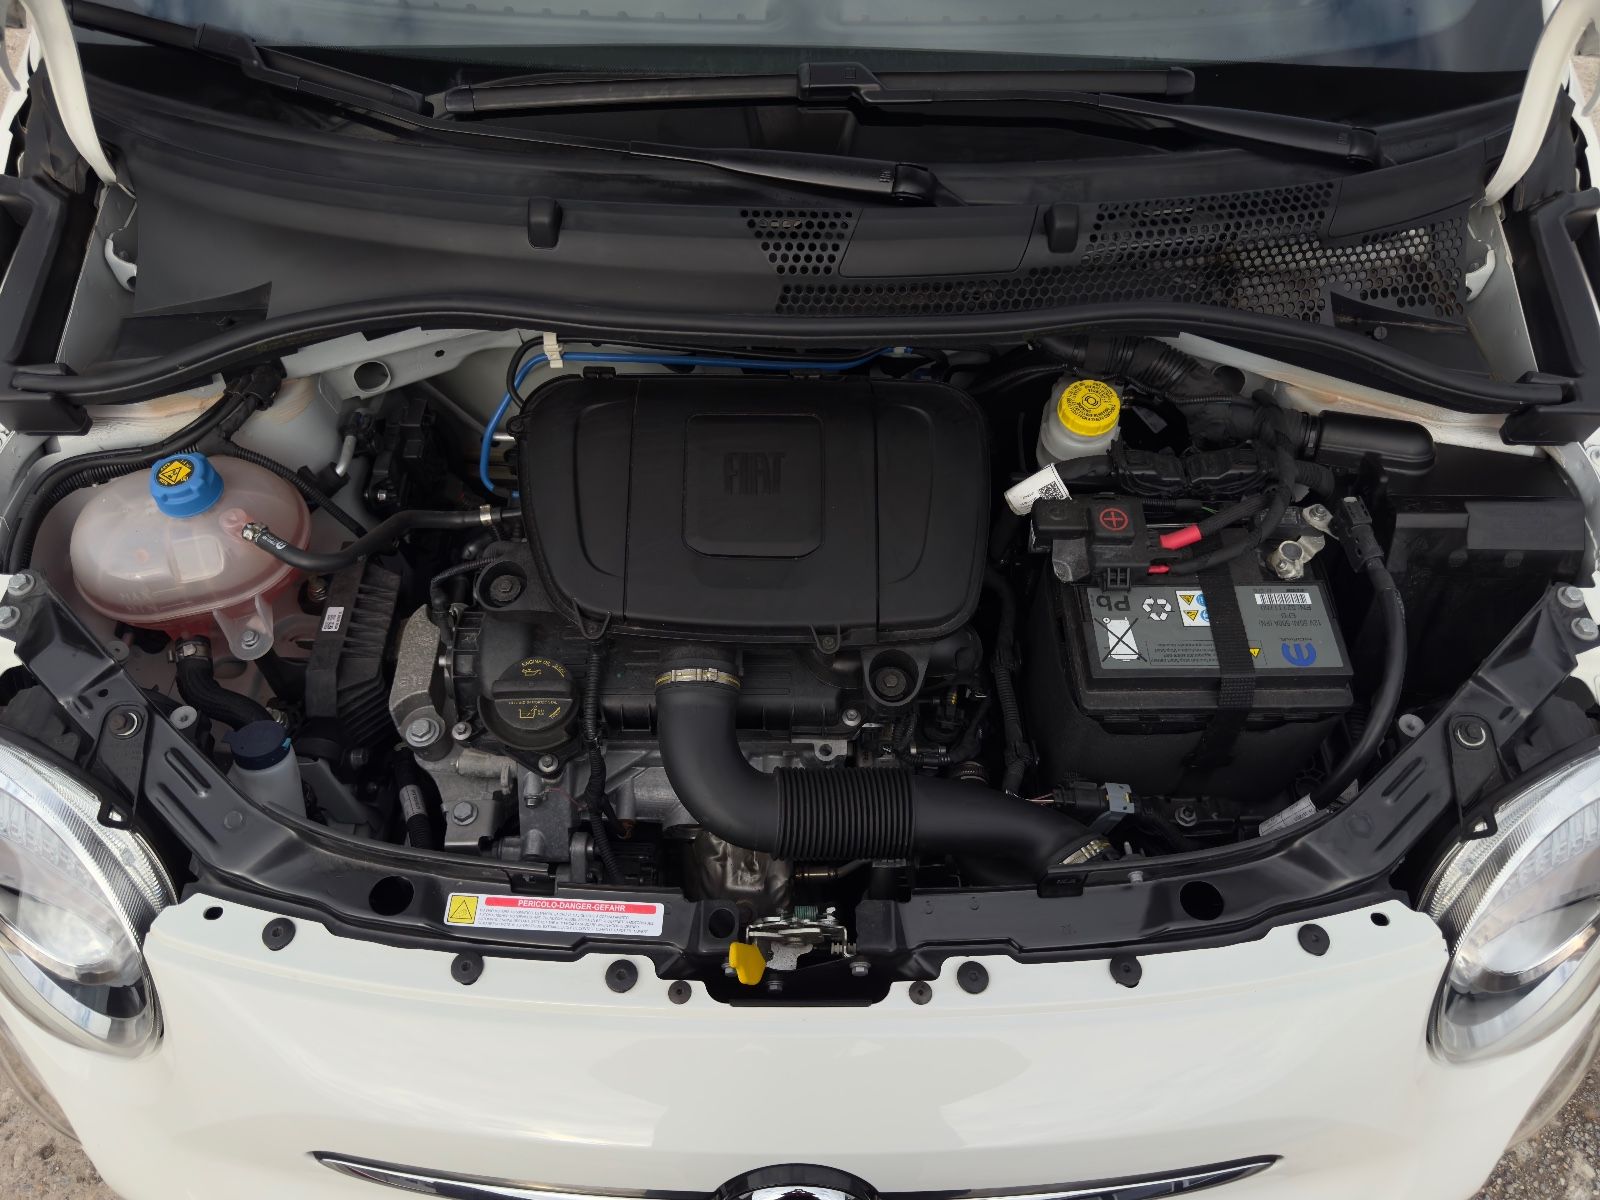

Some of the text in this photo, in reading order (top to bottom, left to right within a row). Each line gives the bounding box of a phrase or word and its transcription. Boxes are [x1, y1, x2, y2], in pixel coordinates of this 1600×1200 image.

[722, 452, 788, 496] FIAT
[1095, 594, 1131, 611] Pb
[517, 899, 626, 912] PERICOLO-DANGER-GEFAHR
